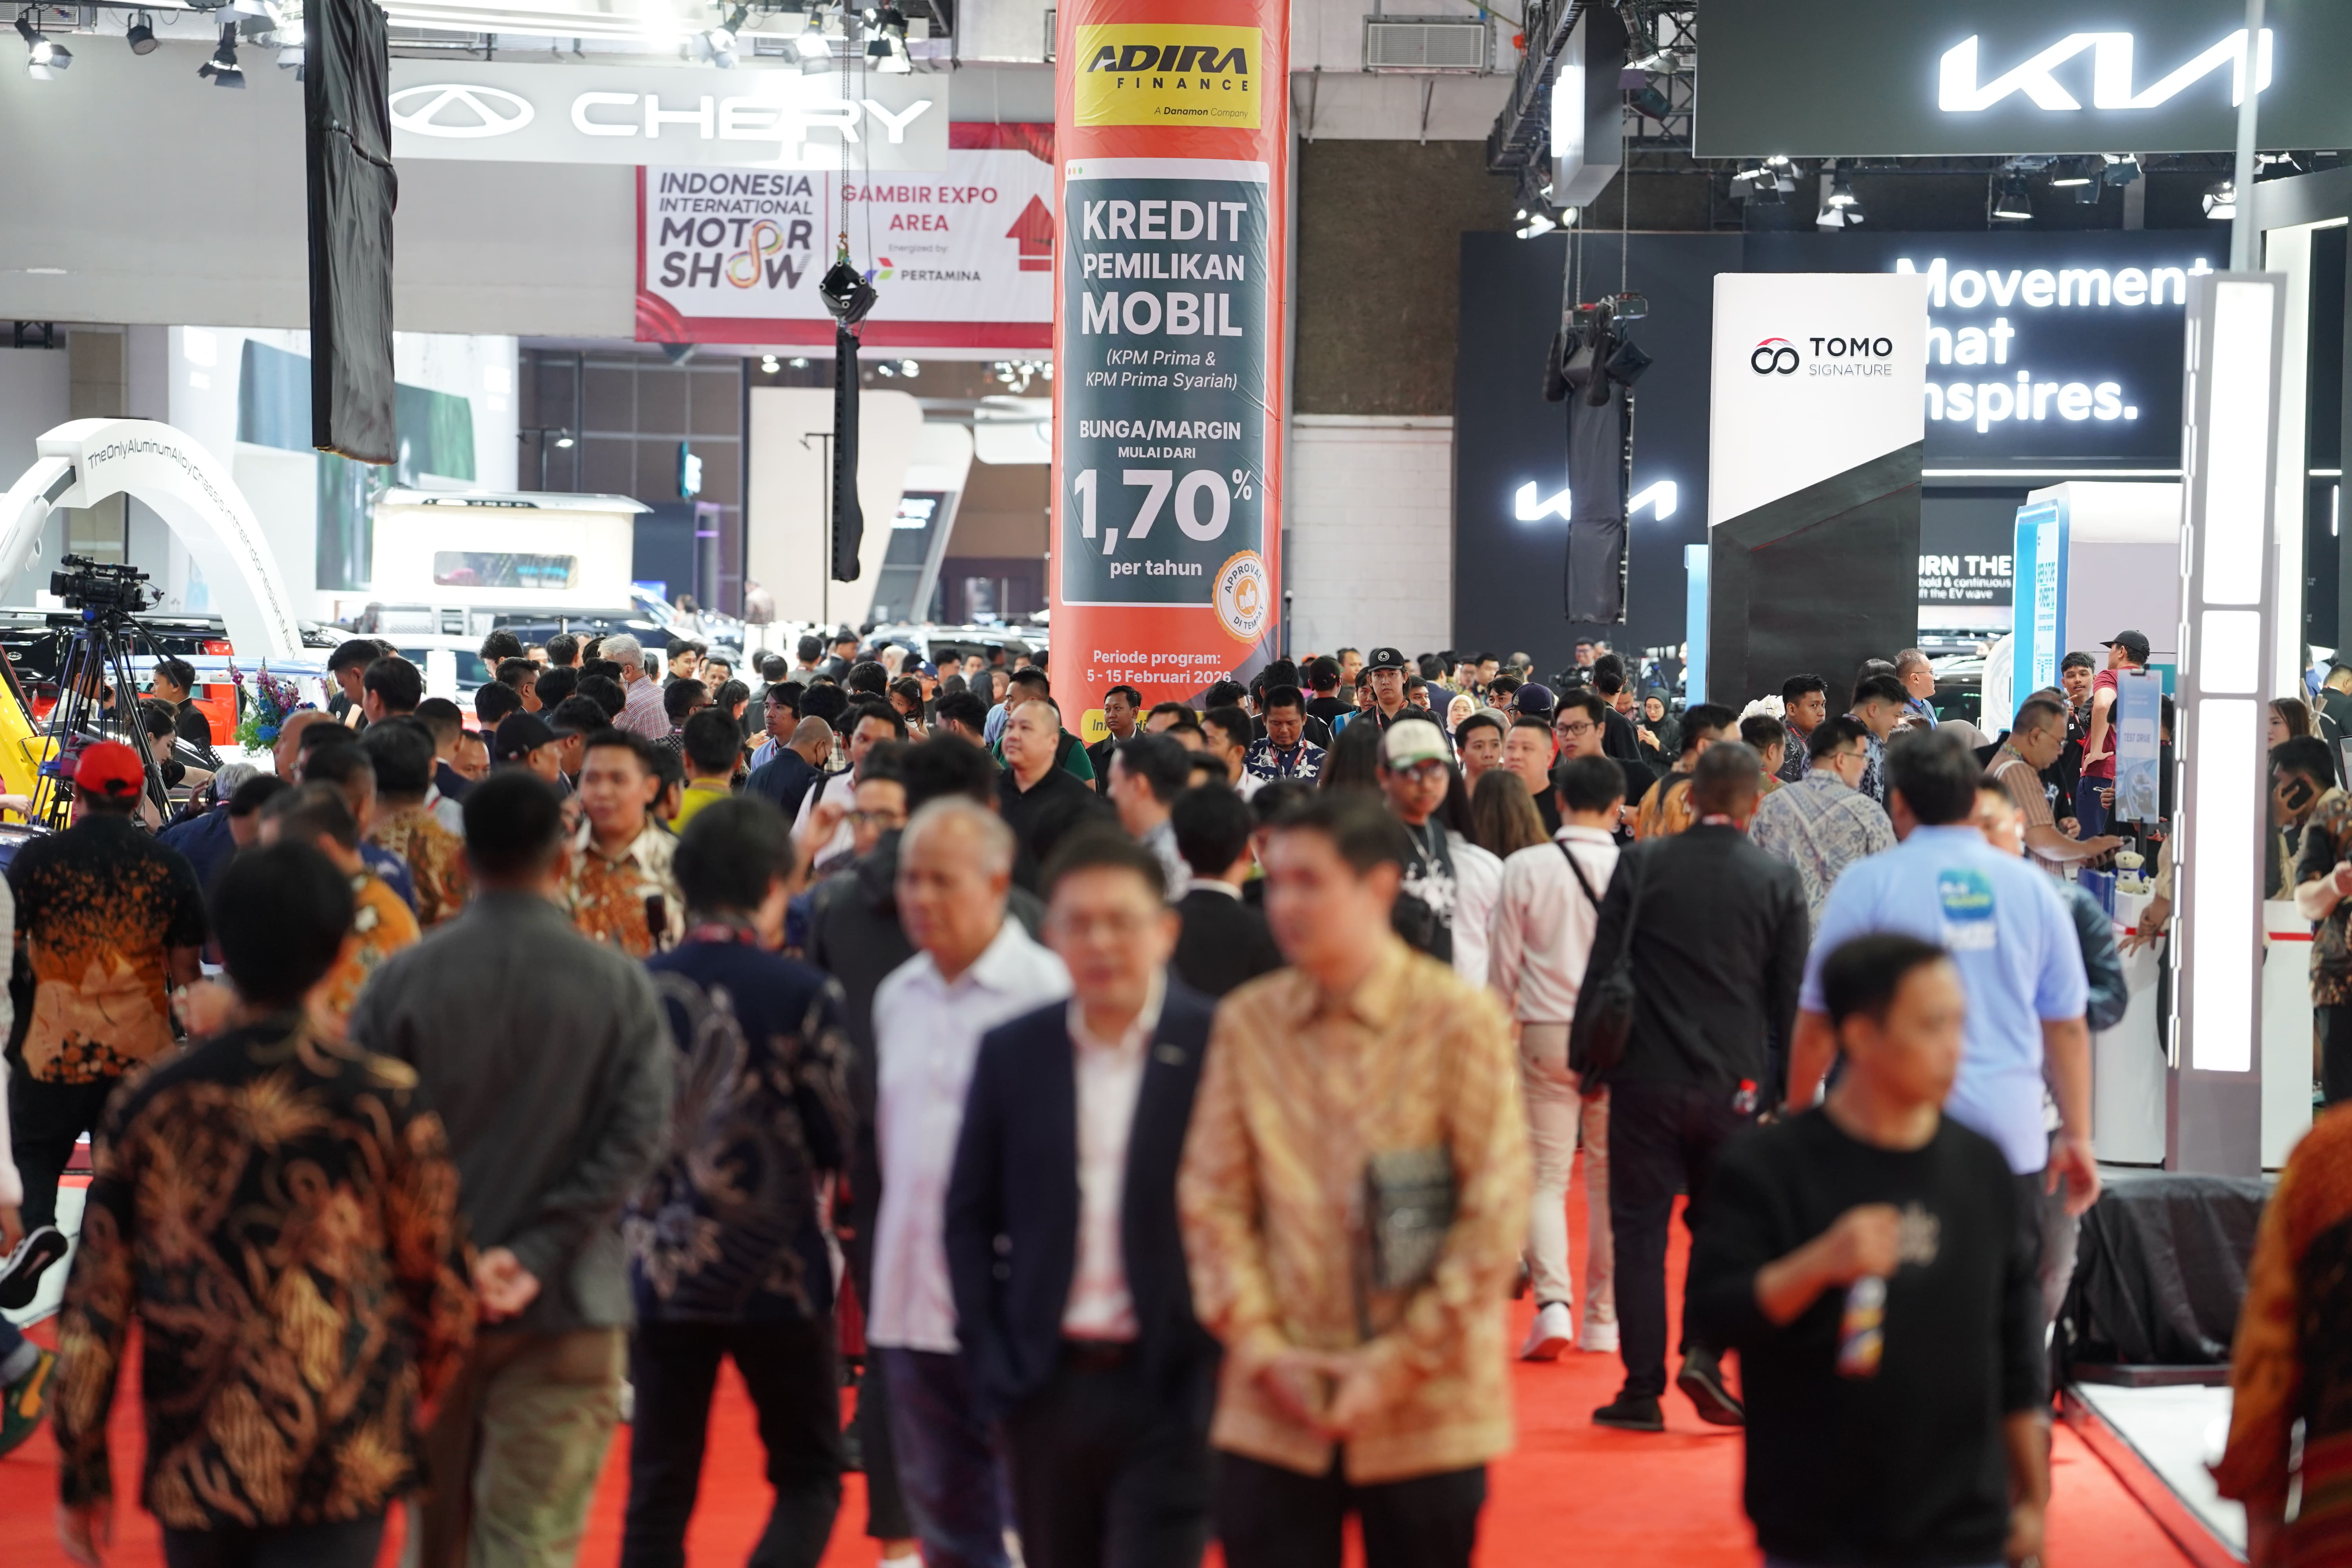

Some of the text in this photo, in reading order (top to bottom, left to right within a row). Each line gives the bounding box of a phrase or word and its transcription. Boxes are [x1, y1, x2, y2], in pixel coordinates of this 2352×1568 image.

[1087, 45, 1248, 74] ADIRA
[1117, 77, 1248, 91] FINANCE
[571, 91, 933, 144] CHERY
[1154, 107, 1248, 119] A Danamon Company
[659, 172, 813, 197] INDONESIA
[842, 185, 998, 203] GAMBIR EXPO
[659, 198, 813, 215] INTERNATIONAL
[889, 214, 949, 231] AREA
[1083, 200, 1247, 242] KREDIT
[888, 244, 933, 254] Energized
[900, 270, 981, 281] PERTAMINA
[1083, 252, 1244, 281] PEMILIKAN
[1082, 291, 1243, 337] MOBIL
[1809, 338, 1893, 357] TOMO
[1926, 315, 2015, 365] hat
[1107, 348, 1216, 366] (KPM Prima &
[1809, 364, 1893, 376] SIGNATURE
[1086, 371, 1237, 391] KPM Prima Syariah)
[1925, 370, 2138, 434] nspires.
[1080, 419, 1241, 440] BUNGA/MARGIN
[1118, 446, 1196, 459] MULAI DARI
[1110, 559, 1202, 579] per tahun
[1918, 555, 1959, 576] RN
[1964, 555, 2012, 576] THE
[1225, 563, 1261, 594] APPROVAL
[1953, 577, 2012, 588] continuous
[1930, 588, 1947, 599] the
[1949, 587, 1964, 599] EV
[1965, 589, 1994, 599] wave
[1233, 604, 1263, 630] DI TEMPAT
[1094, 650, 1221, 667] Periode program:
[1087, 669, 1095, 682] 5
[1106, 669, 1122, 682] 15
[1125, 670, 1190, 683] Februari
[1194, 670, 1231, 683] 2026
[2123, 733, 2136, 742] TEST
